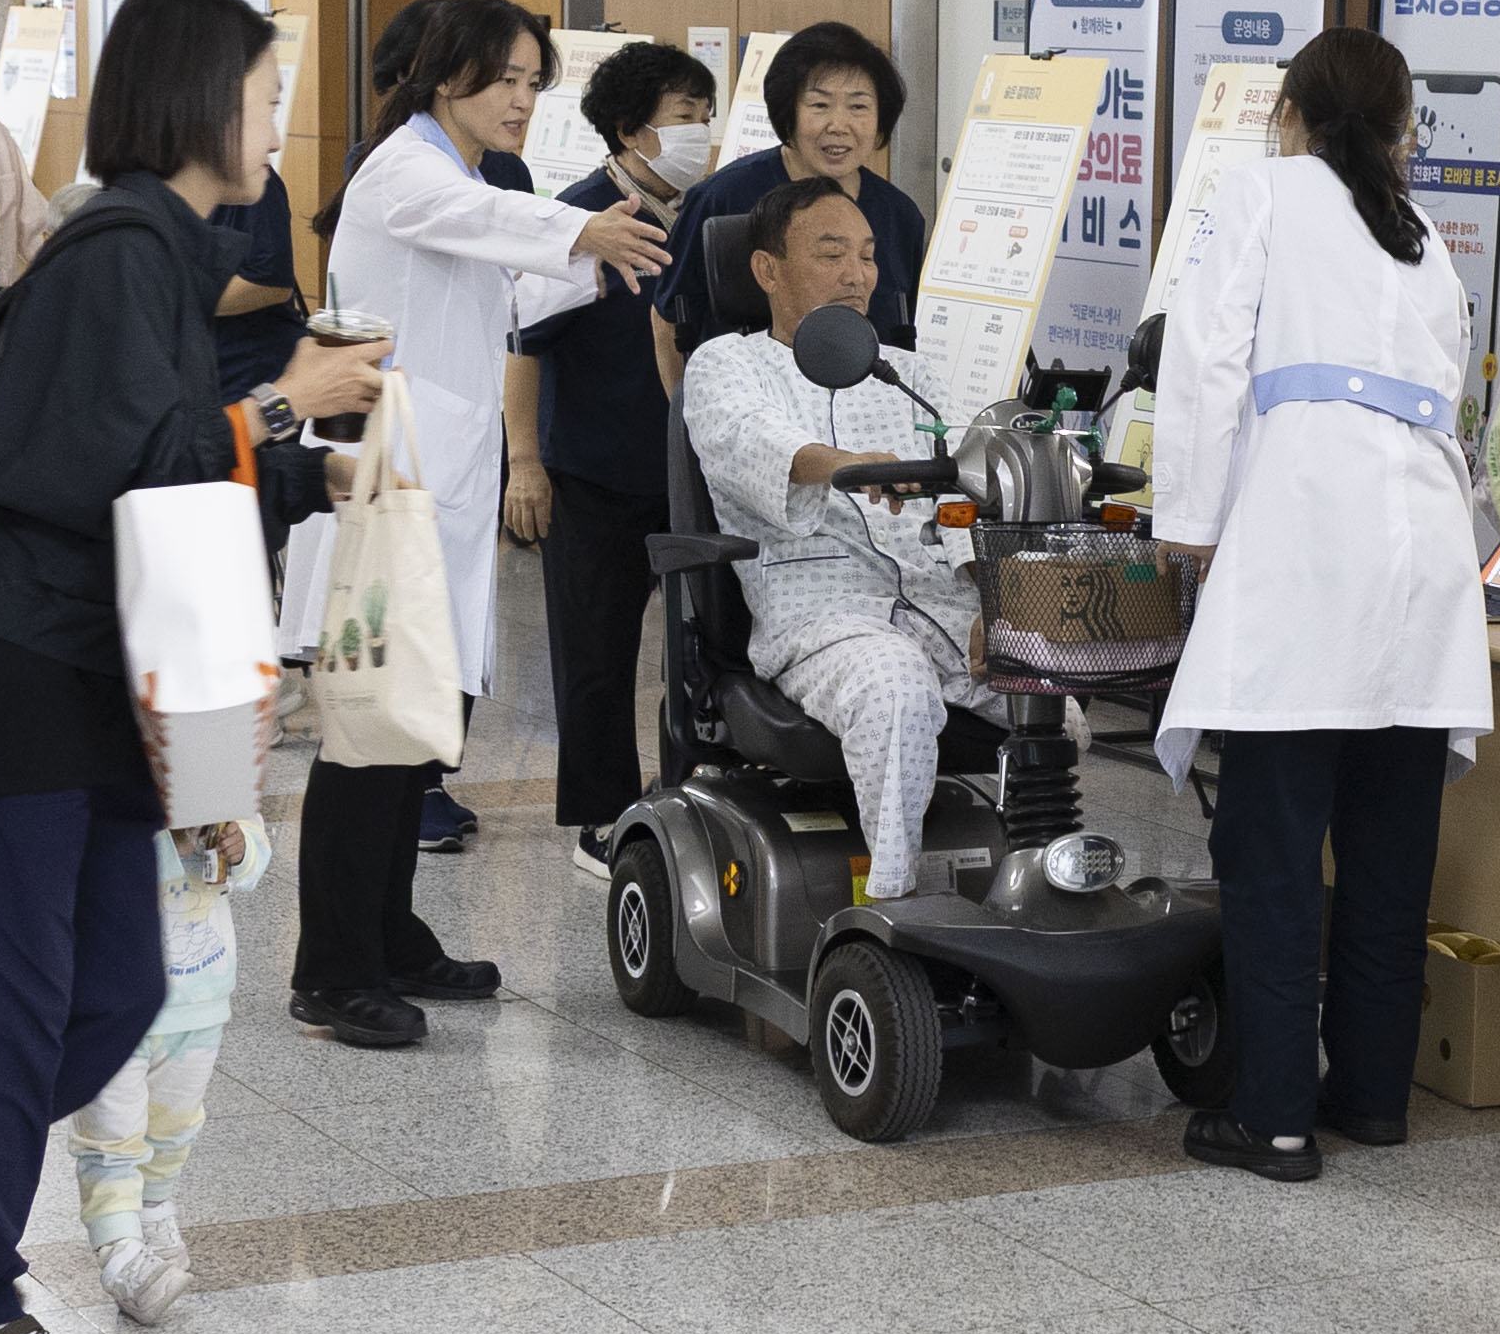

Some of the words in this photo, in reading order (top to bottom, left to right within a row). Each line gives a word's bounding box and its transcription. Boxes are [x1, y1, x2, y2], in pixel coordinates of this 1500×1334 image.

[1080, 17, 1113, 35] 함께하는
[1233, 19, 1271, 38] 운영내용
[750, 50, 763, 77] 7
[981, 71, 995, 100] 8
[1212, 81, 1226, 113] 9
[1244, 89, 1261, 104] 우리
[1238, 109, 1270, 126] 생각하는
[1412, 165, 1441, 183] 친화적
[1443, 167, 1472, 186] 모바일
[1062, 196, 1141, 249] 비스
[1048, 325, 1081, 347] 편리하게
